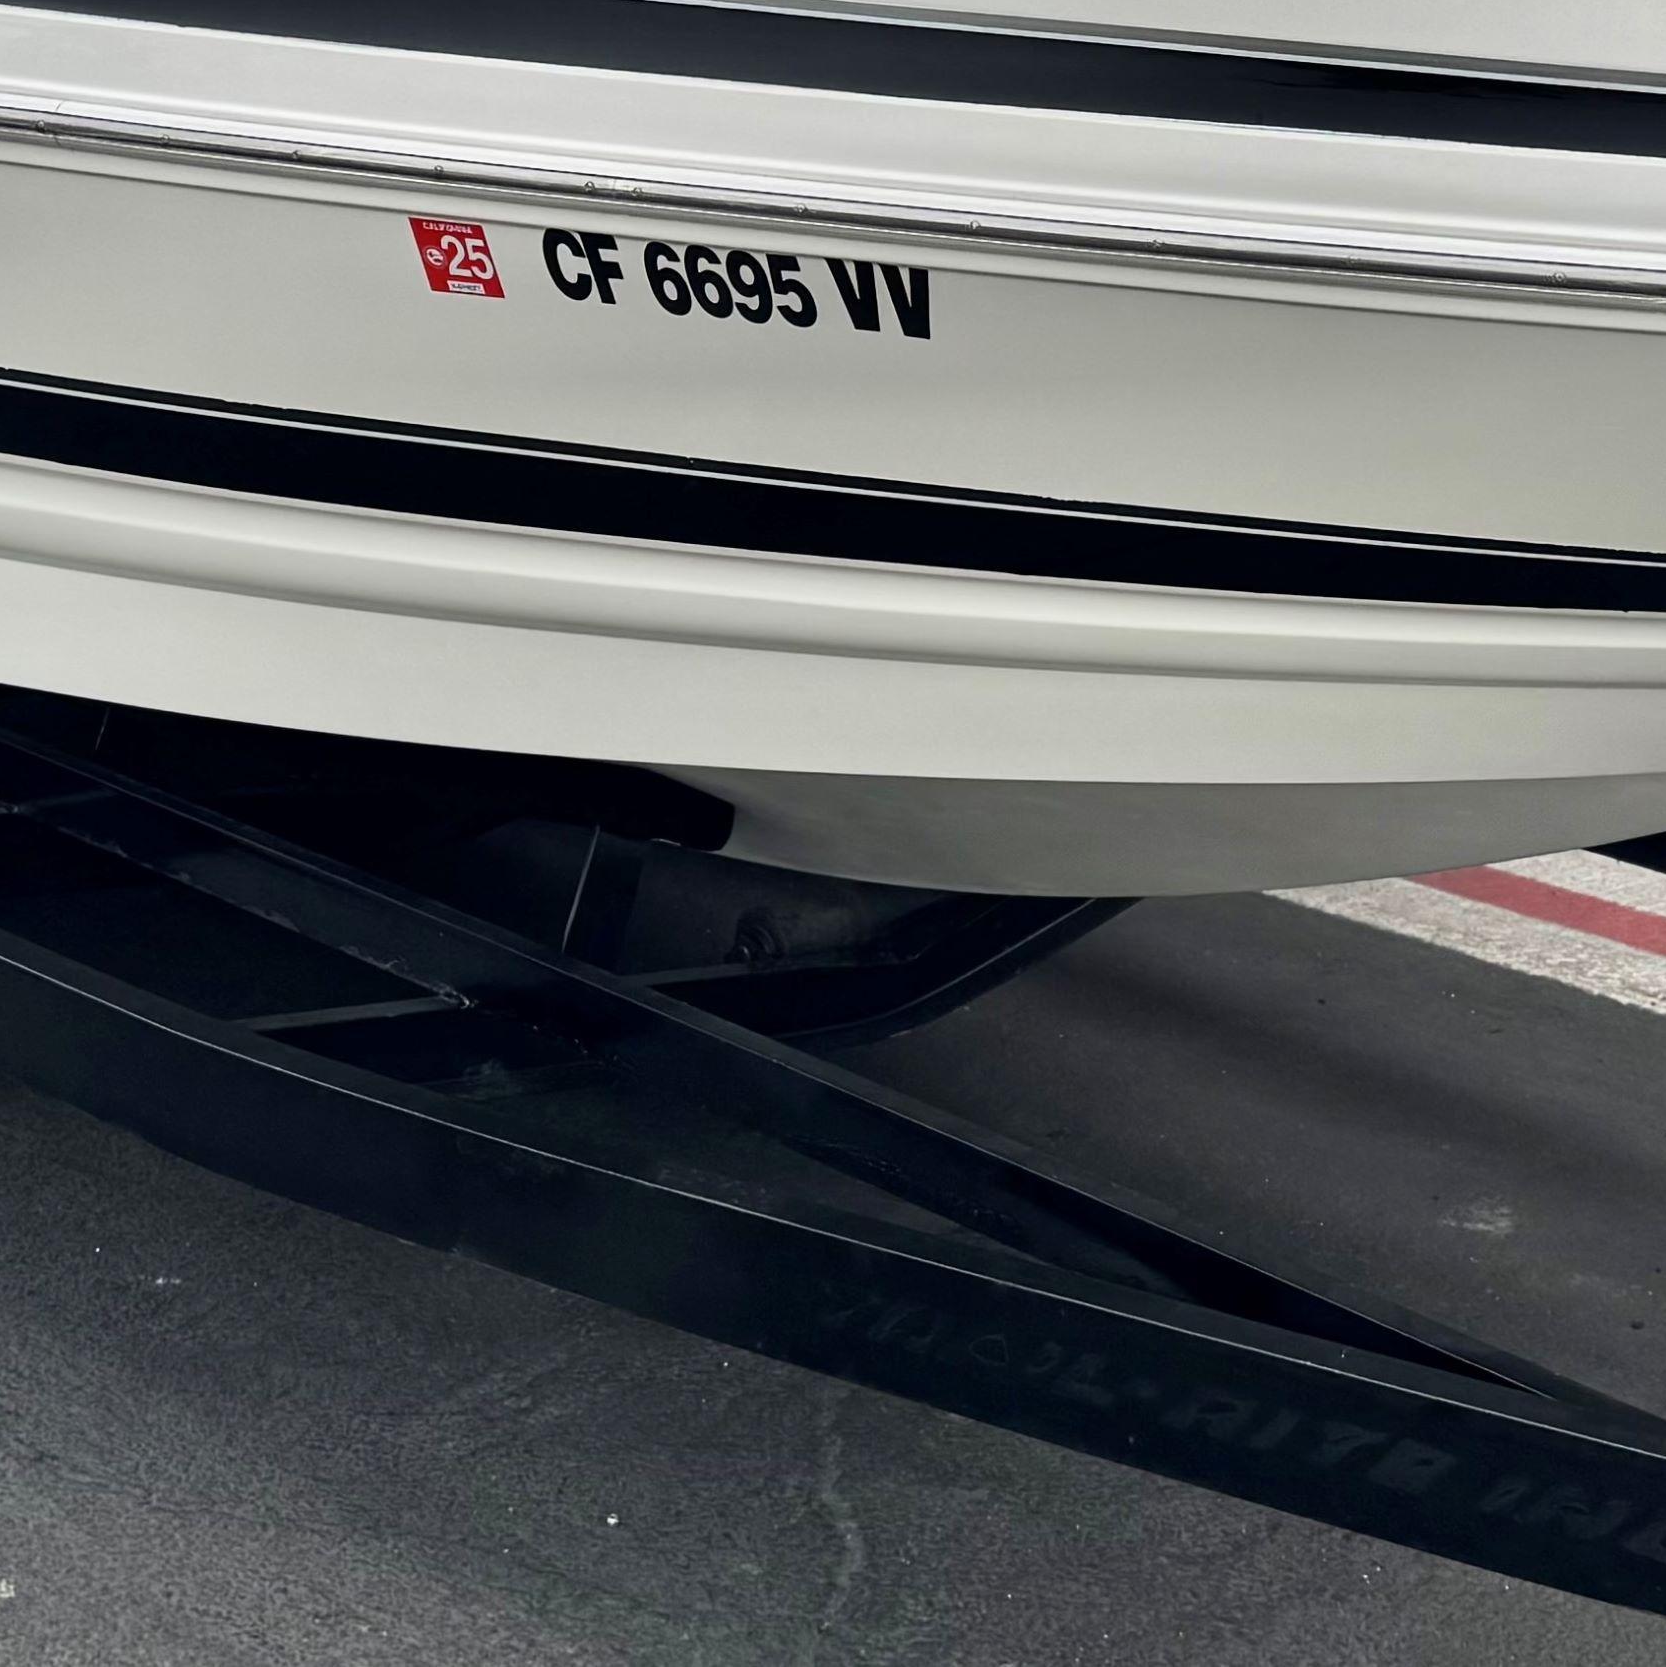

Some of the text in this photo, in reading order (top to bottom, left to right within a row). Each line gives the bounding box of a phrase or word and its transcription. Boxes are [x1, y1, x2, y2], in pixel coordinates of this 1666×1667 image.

[440, 234, 494, 280] 25
[542, 227, 624, 305] CF
[643, 240, 818, 328] 6695
